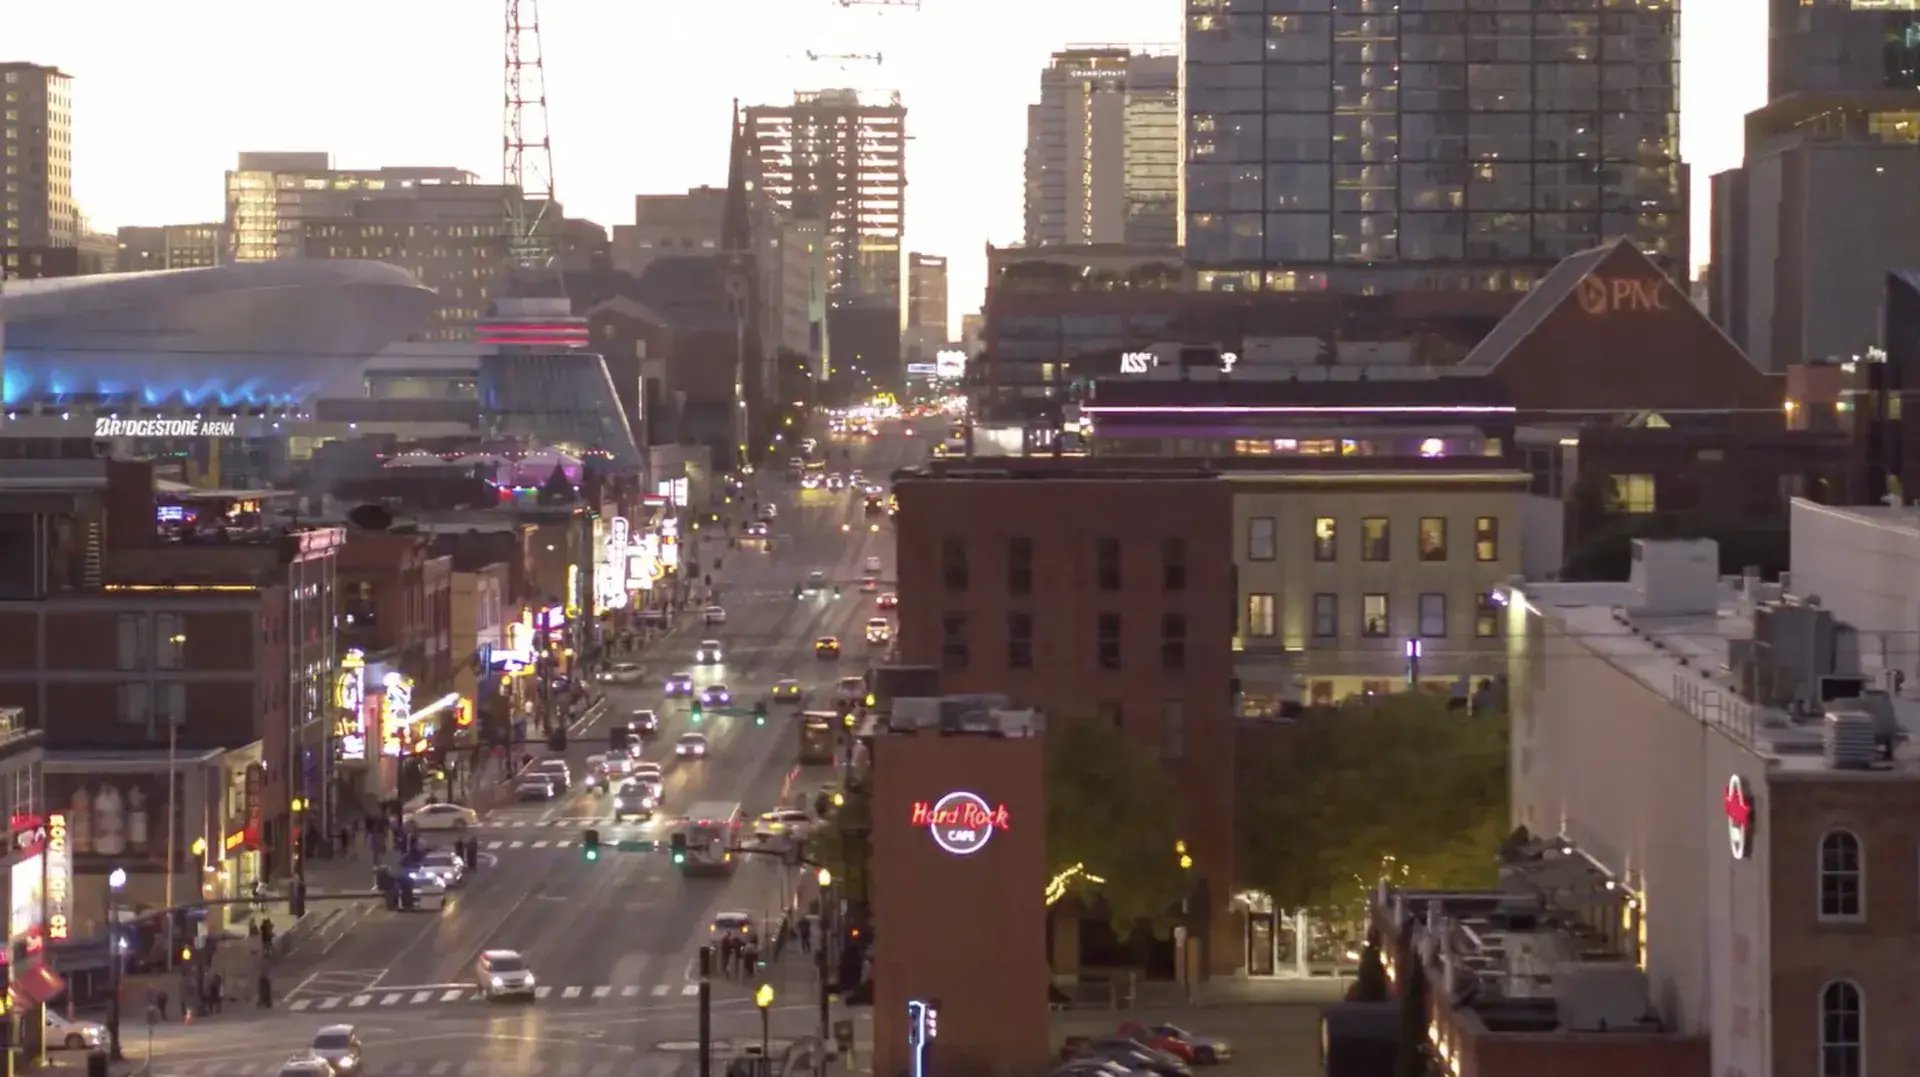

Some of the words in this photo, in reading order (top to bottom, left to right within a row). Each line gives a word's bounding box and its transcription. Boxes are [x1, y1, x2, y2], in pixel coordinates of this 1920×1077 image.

[1611, 279, 1672, 311] PNC
[200, 421, 235, 436] ARENA
[912, 802, 960, 824] Hard
[963, 802, 1009, 828] Rock
